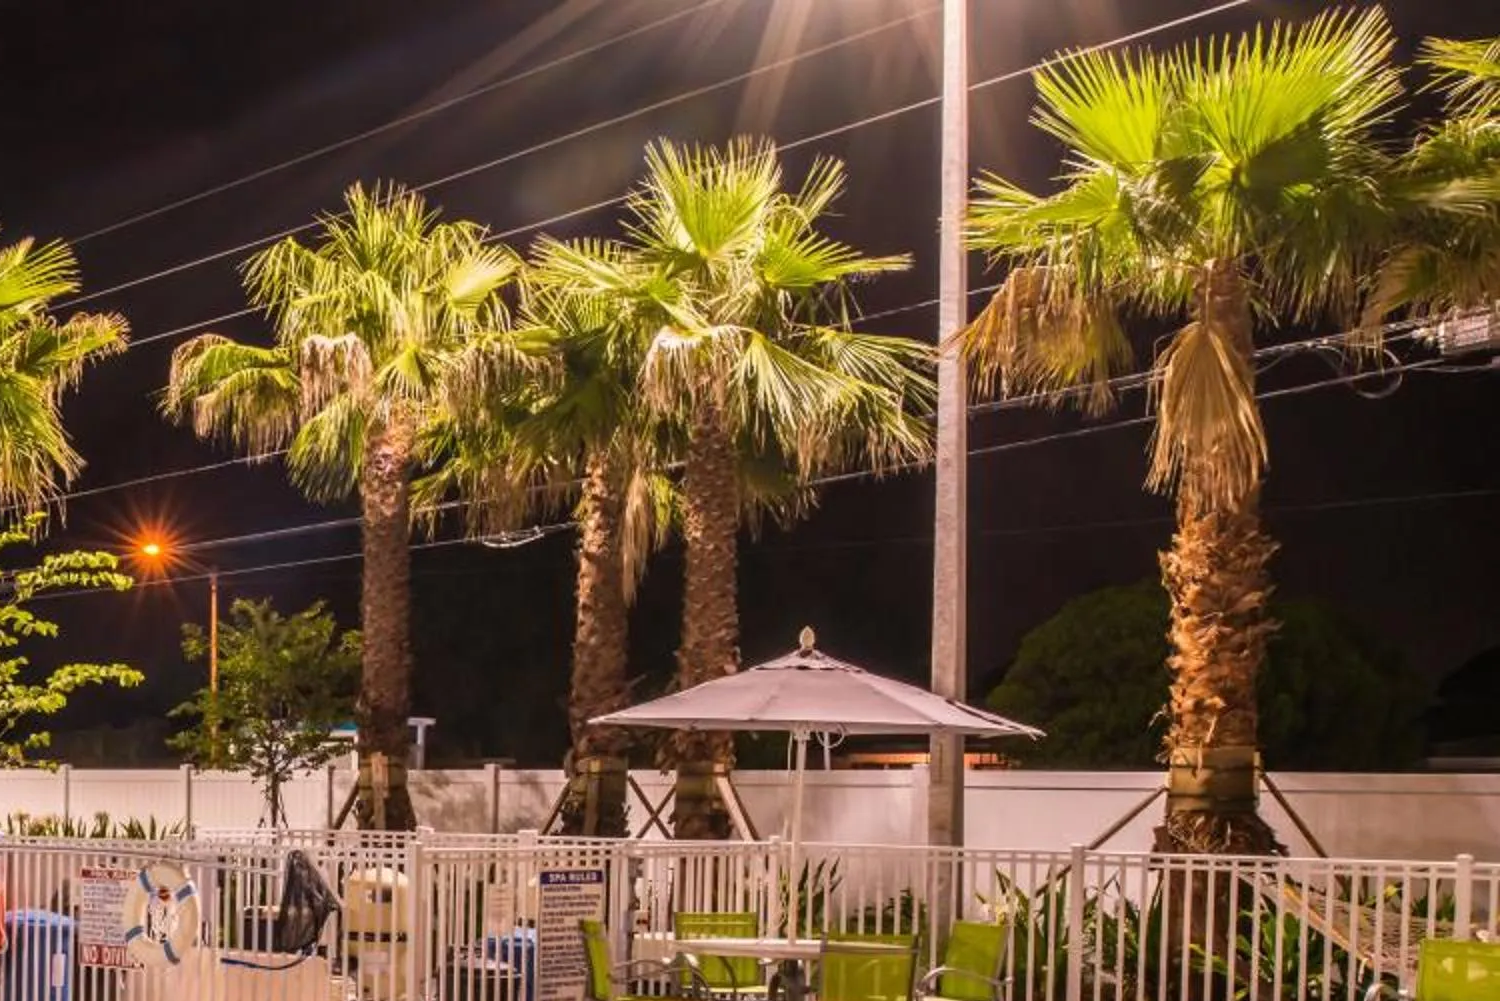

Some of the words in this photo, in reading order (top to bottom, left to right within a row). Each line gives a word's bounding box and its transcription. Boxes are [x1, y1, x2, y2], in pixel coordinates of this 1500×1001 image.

[549, 873, 566, 883] SPA
[569, 872, 597, 882] RULES
[83, 945, 99, 964] NO
[102, 946, 128, 966] DIVI
